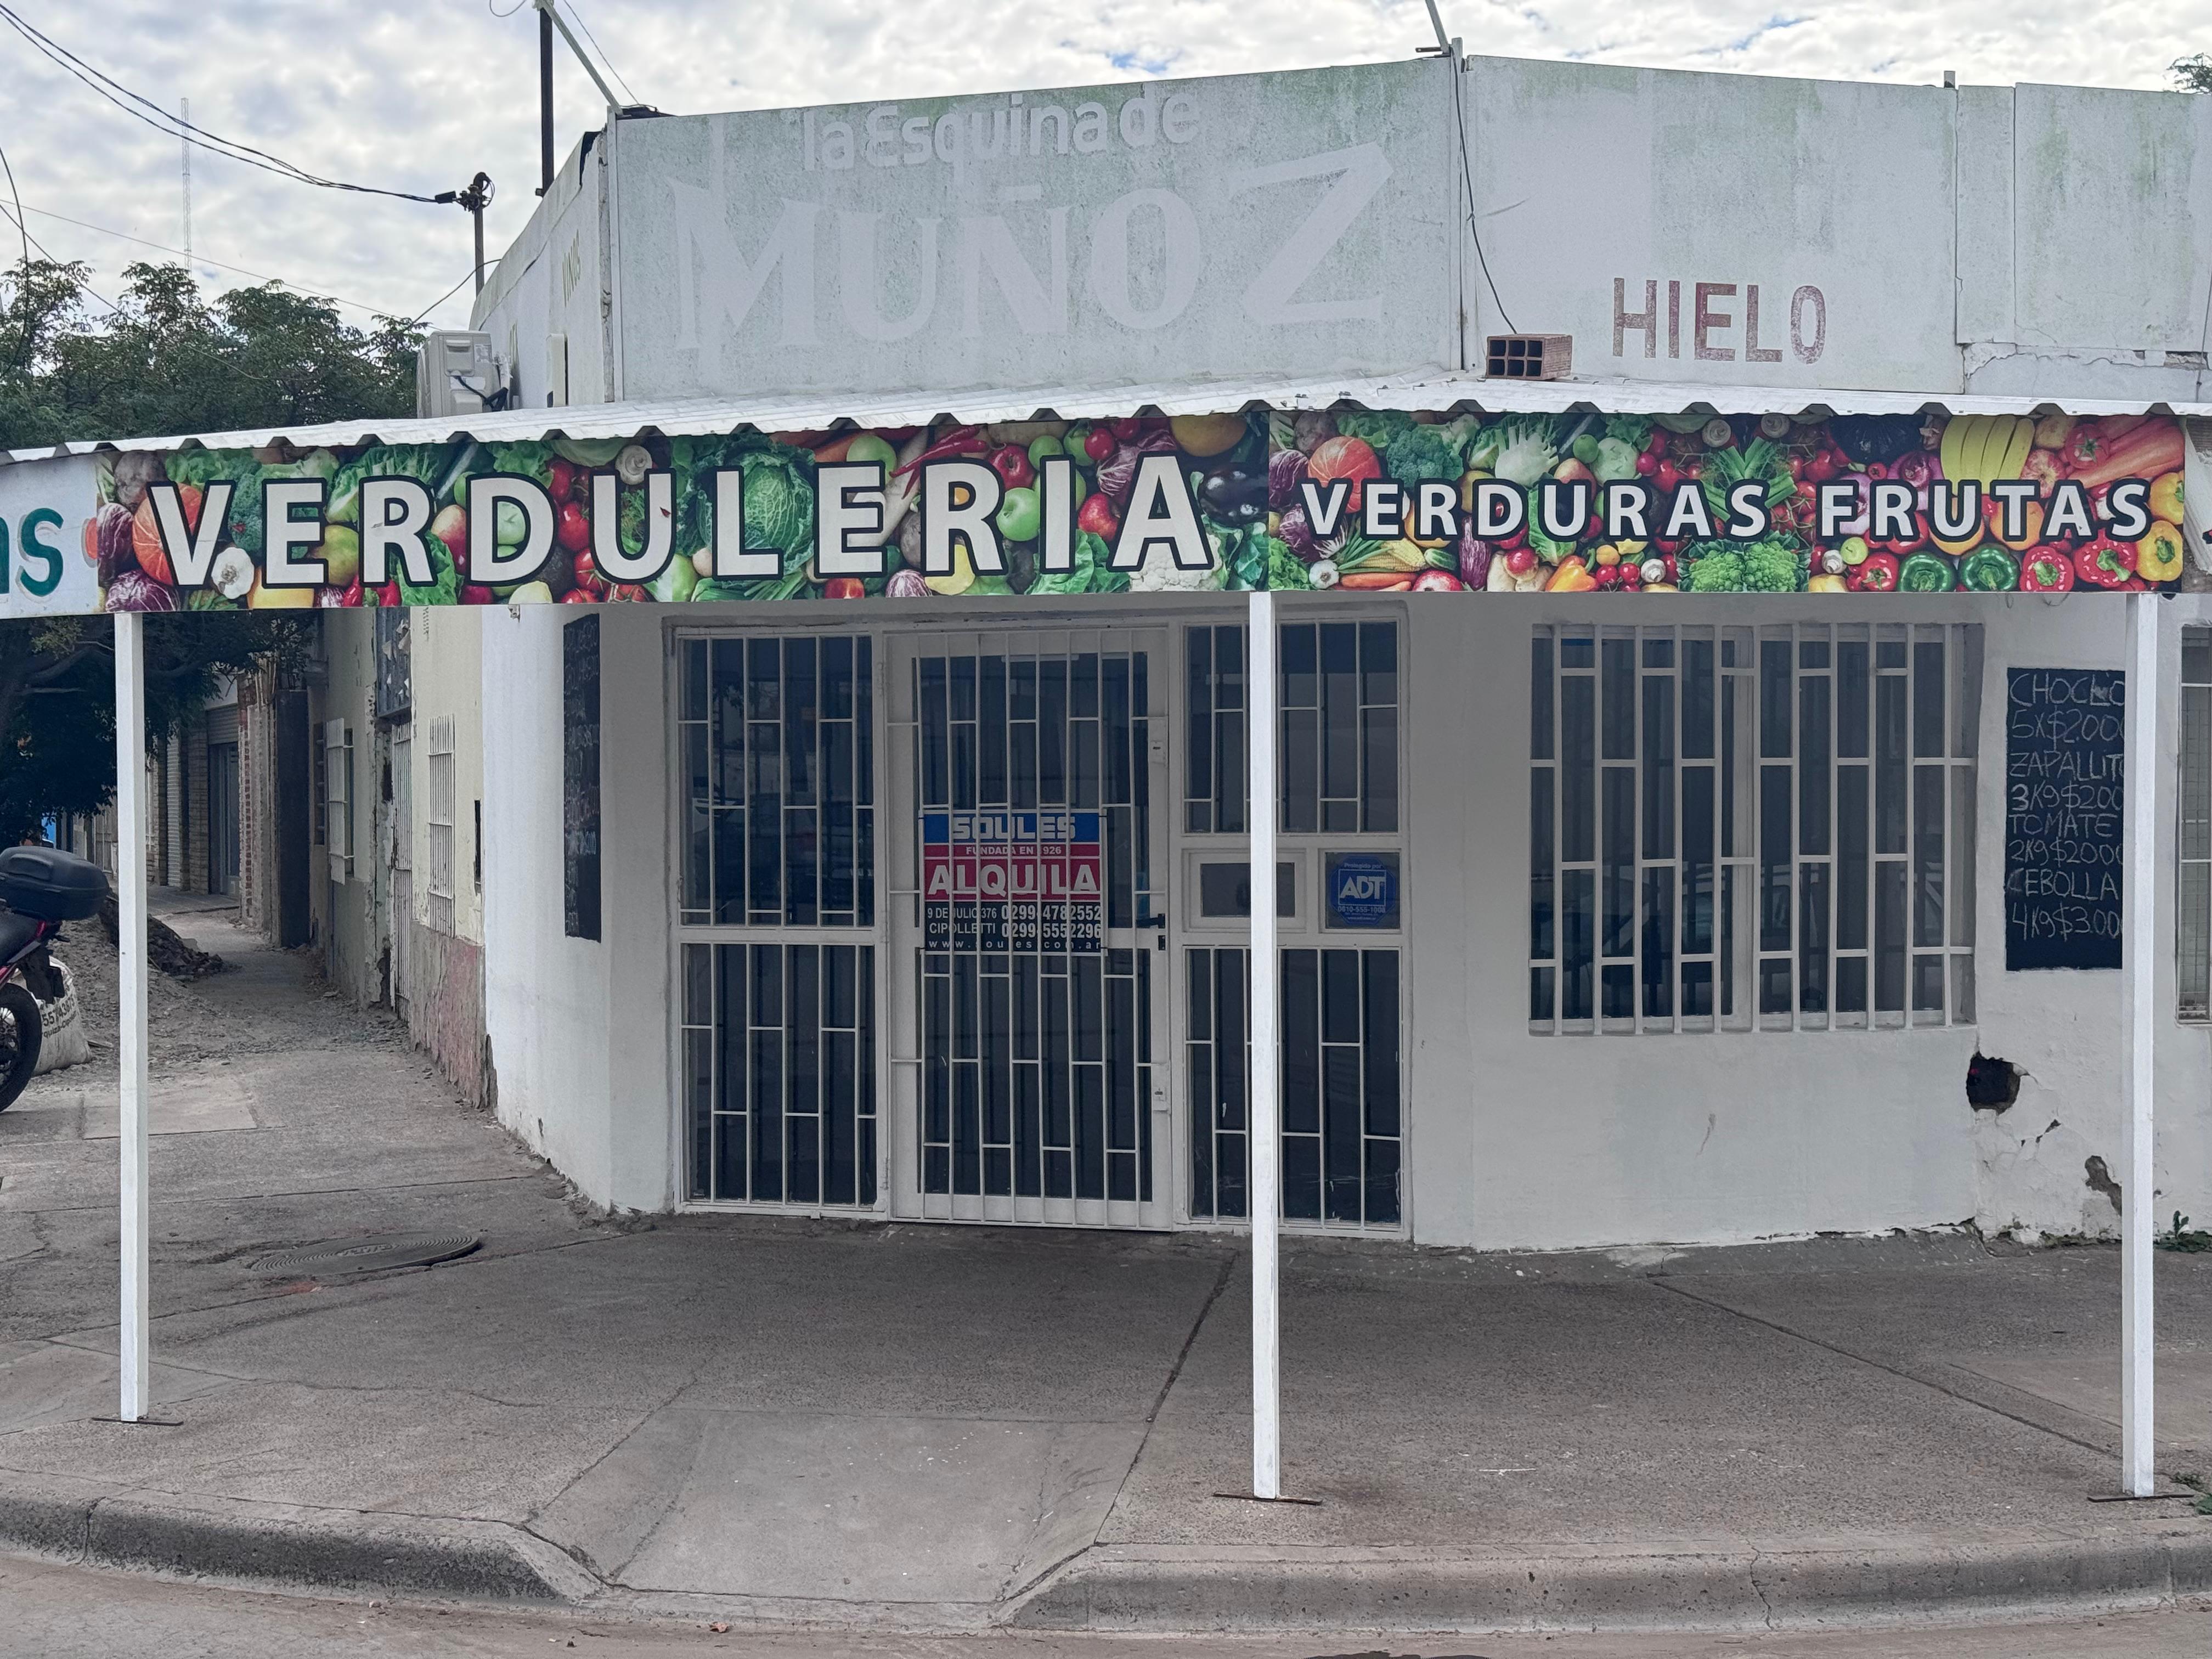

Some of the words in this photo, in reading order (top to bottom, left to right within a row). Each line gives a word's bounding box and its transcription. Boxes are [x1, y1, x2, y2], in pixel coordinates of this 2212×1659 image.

[662, 140, 1395, 349] MUÑOZ
[1612, 277, 1827, 365] HIELO
[147, 453, 1211, 587] VERDULERIA
[1300, 481, 1768, 538] VERDURAS
[1819, 483, 2151, 538] FRUTAS
[2010, 673, 2124, 707] CHOCLO
[952, 816, 1075, 839] SOULES
[2008, 810, 2118, 838] TOMATE
[1019, 847, 1034, 855] EN
[1040, 846, 1062, 855] 926
[928, 864, 1098, 897] ALQUILA
[1340, 876, 1386, 900] ADT
[2007, 868, 2119, 901] CEBOLLA
[928, 907, 933, 919] 9
[935, 907, 949, 918] DE
[980, 907, 997, 919] 376
